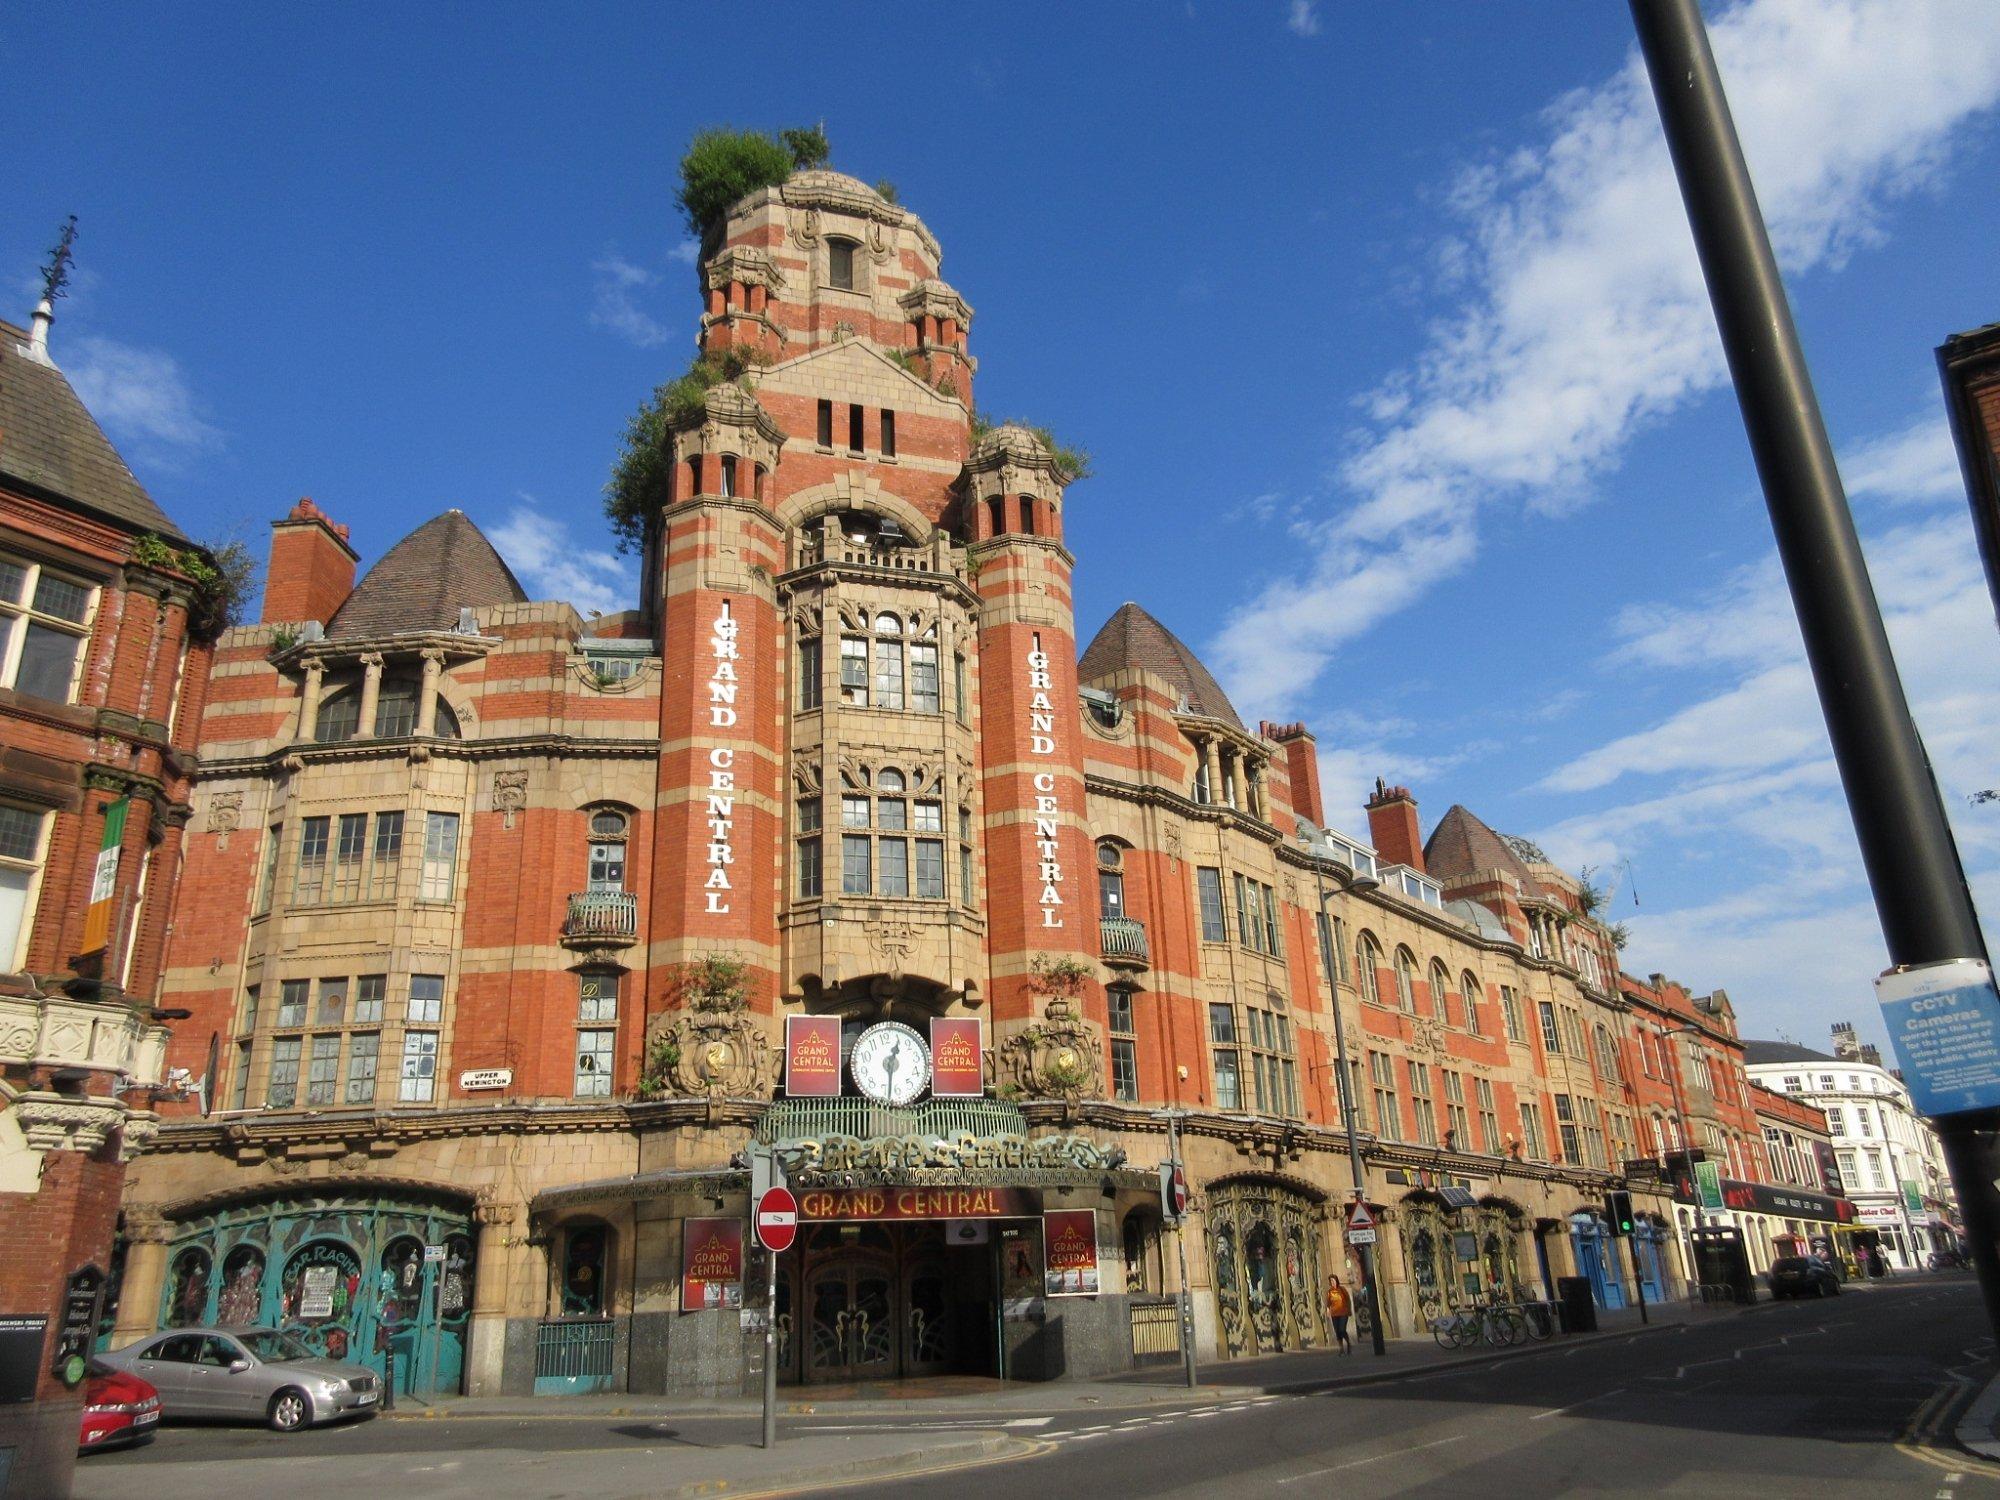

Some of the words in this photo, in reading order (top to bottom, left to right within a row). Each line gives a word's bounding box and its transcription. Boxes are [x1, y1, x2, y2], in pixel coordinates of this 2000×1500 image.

[708, 618, 739, 728] GRAND
[1026, 651, 1056, 755] GRAND
[704, 748, 737, 914] CENTRAL
[1033, 773, 1064, 929] CENTRAL
[1911, 993, 1958, 1013] CCTV
[1905, 1009, 1981, 1031] Cameras
[797, 1046, 829, 1056] GRAND
[940, 1047, 971, 1056] GRAND
[793, 1056, 834, 1067] CENTRAL
[937, 1056, 976, 1067] CENTRAL
[911, 1065, 921, 1077] 4
[803, 1192, 886, 1217] GRAND
[898, 1190, 1000, 1215] CENTRAL
[1053, 1242, 1086, 1252] GRAND
[695, 1252, 730, 1264] GRAND
[1050, 1252, 1092, 1264] CENTRAL
[690, 1264, 735, 1276] CENTRAL
